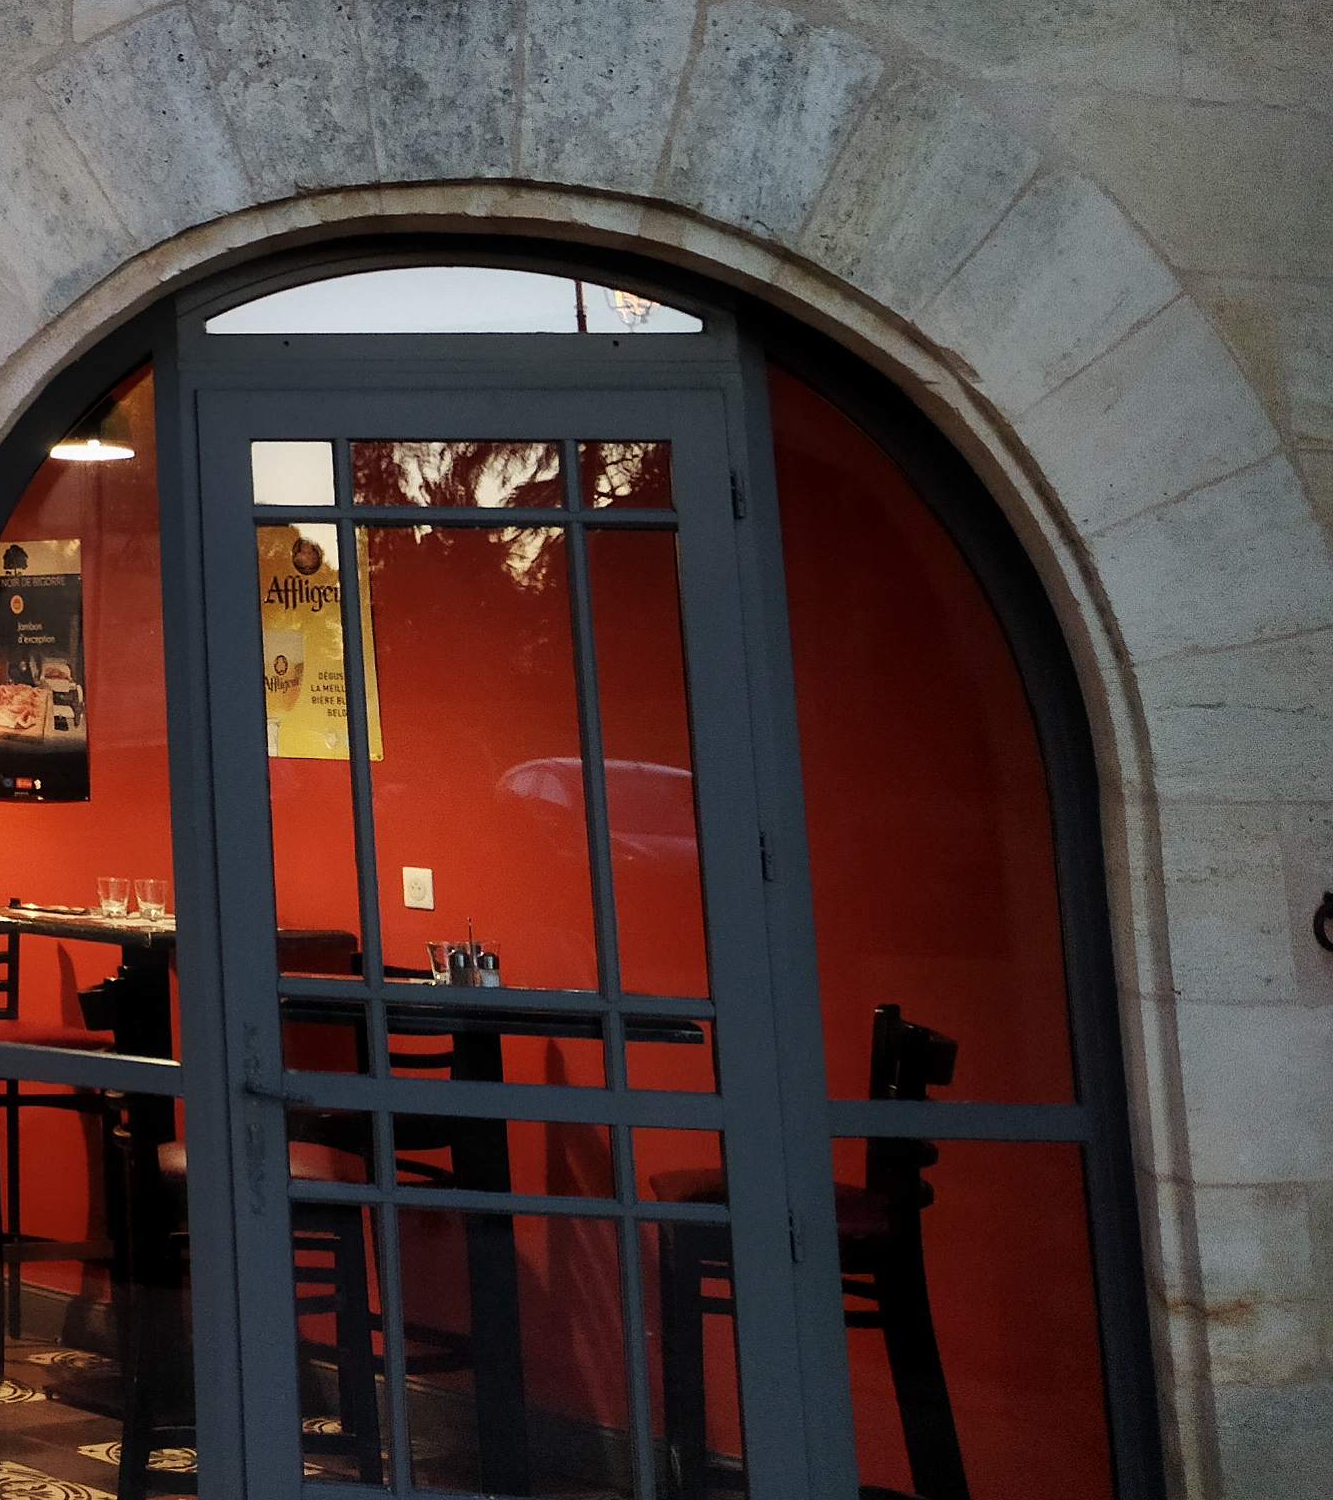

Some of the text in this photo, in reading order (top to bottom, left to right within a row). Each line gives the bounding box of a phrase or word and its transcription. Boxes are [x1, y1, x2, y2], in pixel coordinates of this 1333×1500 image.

[317, 671, 344, 681] DÉGUS
[322, 684, 346, 693] MEILL
[327, 708, 347, 718] BELG
